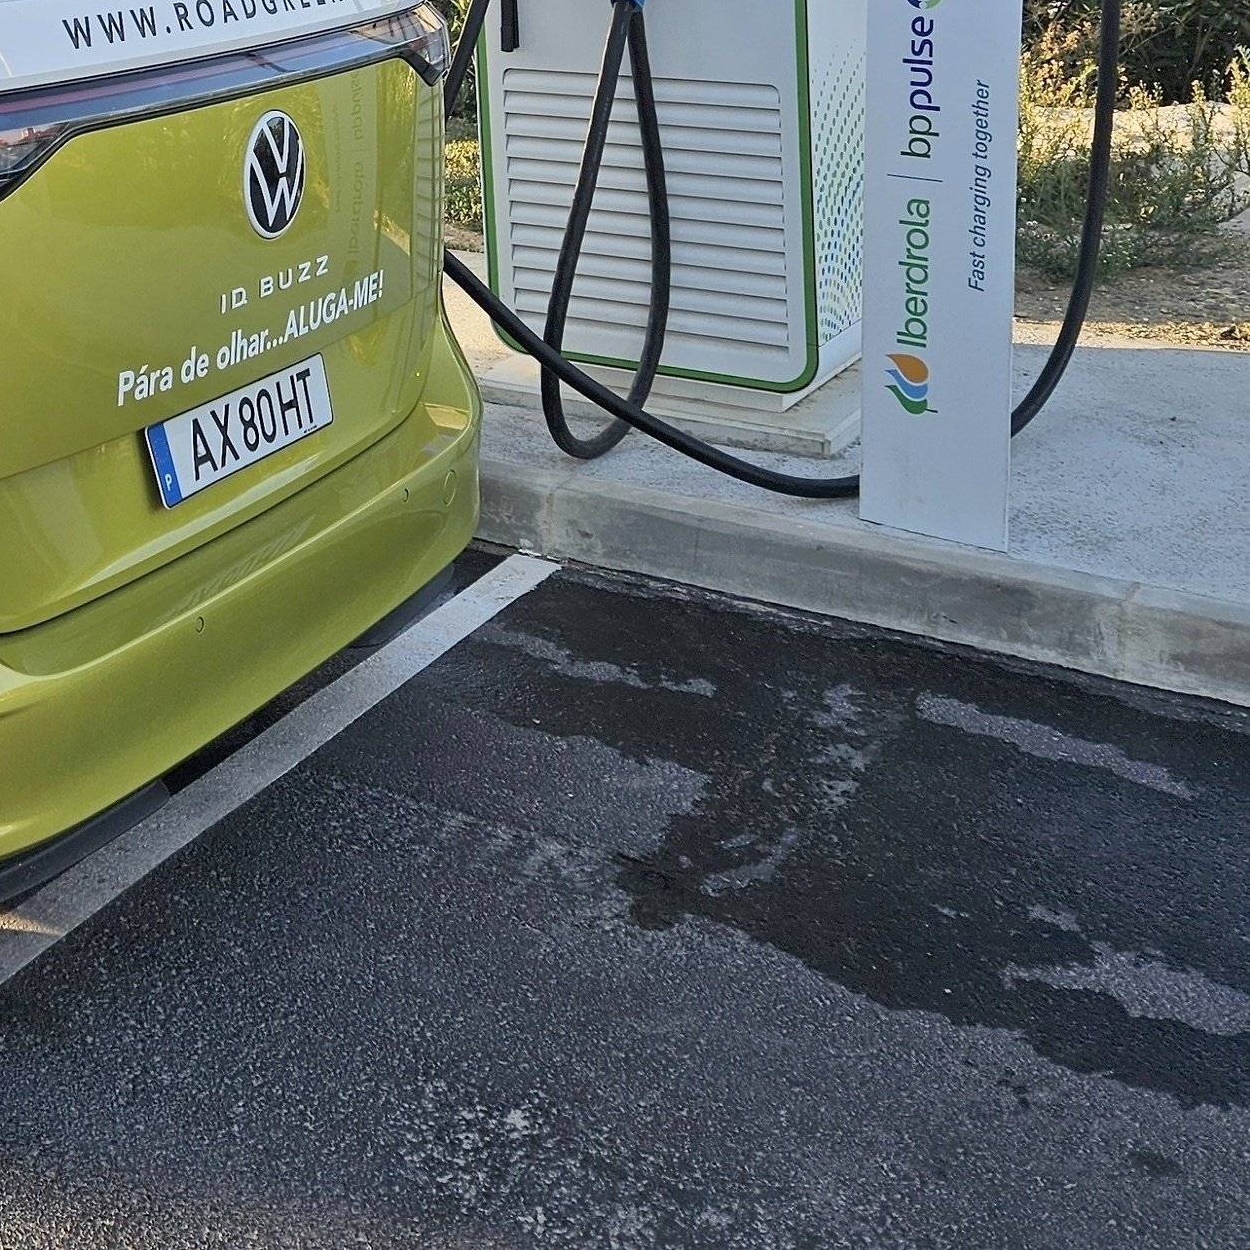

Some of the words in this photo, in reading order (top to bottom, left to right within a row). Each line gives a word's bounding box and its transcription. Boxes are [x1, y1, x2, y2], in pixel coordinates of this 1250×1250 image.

[970, 79, 993, 160] together
[968, 163, 992, 247] charging
[259, 255, 329, 299] BUZZ
[896, 197, 930, 348] Iberdrola
[968, 250, 985, 292] Fast
[117, 364, 173, 407] Pára
[180, 345, 210, 385] de
[164, 472, 174, 492] P
